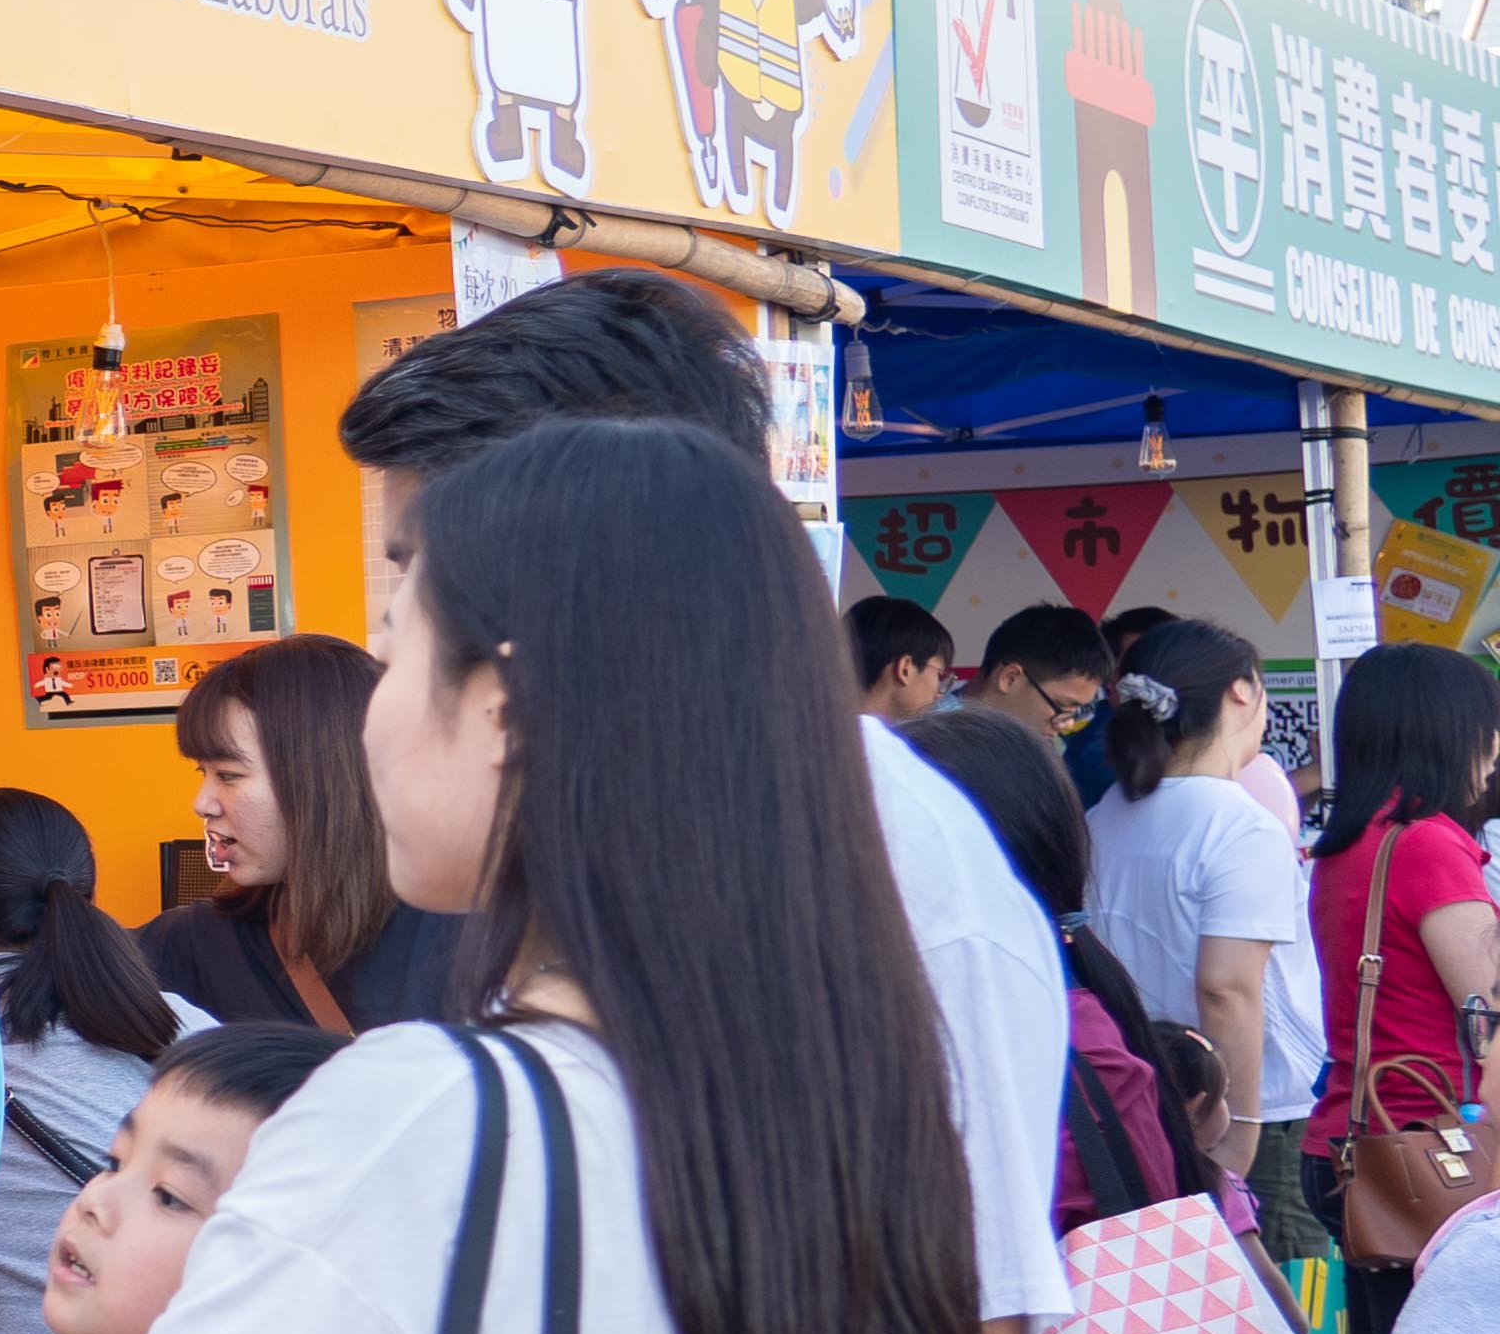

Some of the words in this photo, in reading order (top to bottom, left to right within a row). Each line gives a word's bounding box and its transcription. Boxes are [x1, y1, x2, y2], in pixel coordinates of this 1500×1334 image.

[1271, 23, 1500, 274] 消費者委
[1285, 244, 1402, 347] CONSELHO
[1411, 282, 1441, 356] DE
[86, 670, 149, 690] $10,000
